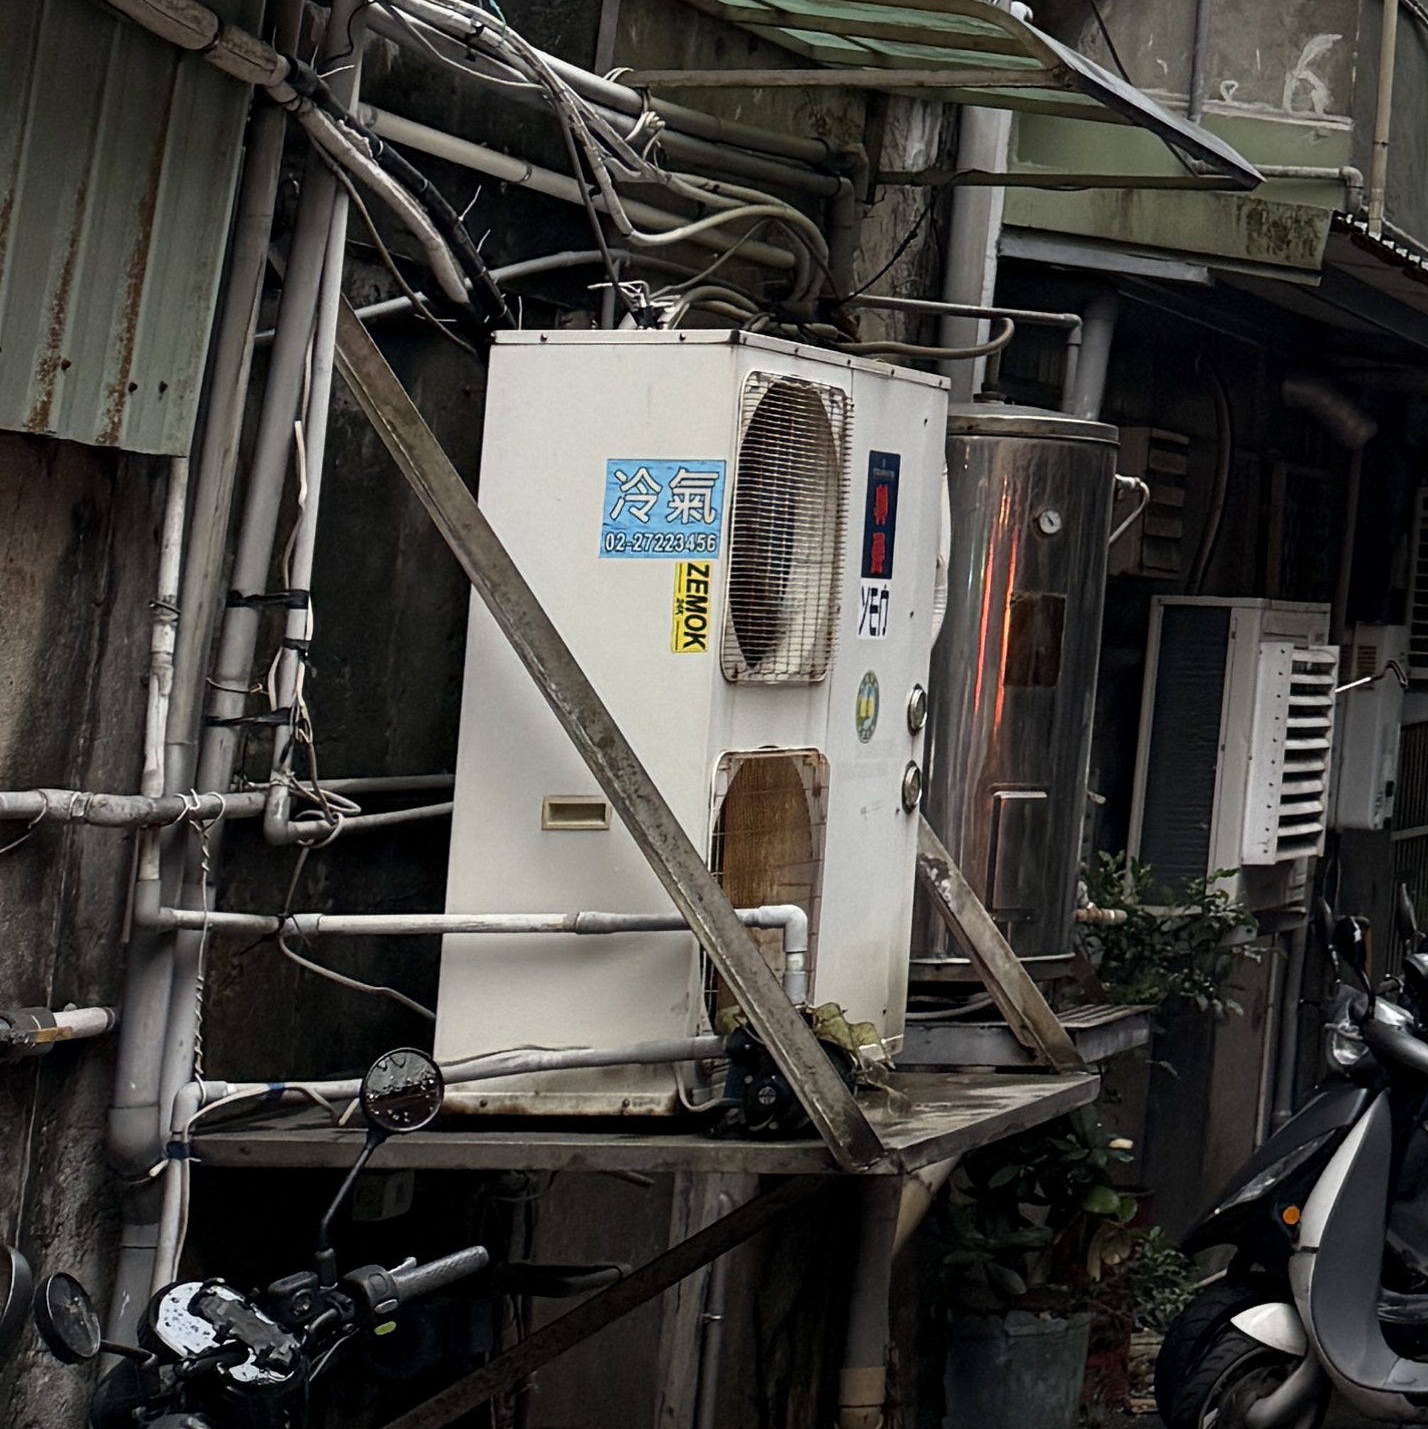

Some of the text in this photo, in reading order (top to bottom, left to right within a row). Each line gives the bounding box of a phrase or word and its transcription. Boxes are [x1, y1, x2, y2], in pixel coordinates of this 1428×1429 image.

[609, 466, 719, 524] 冷氣
[604, 531, 716, 553] 02-27223456
[682, 562, 710, 651] ZEMOK
